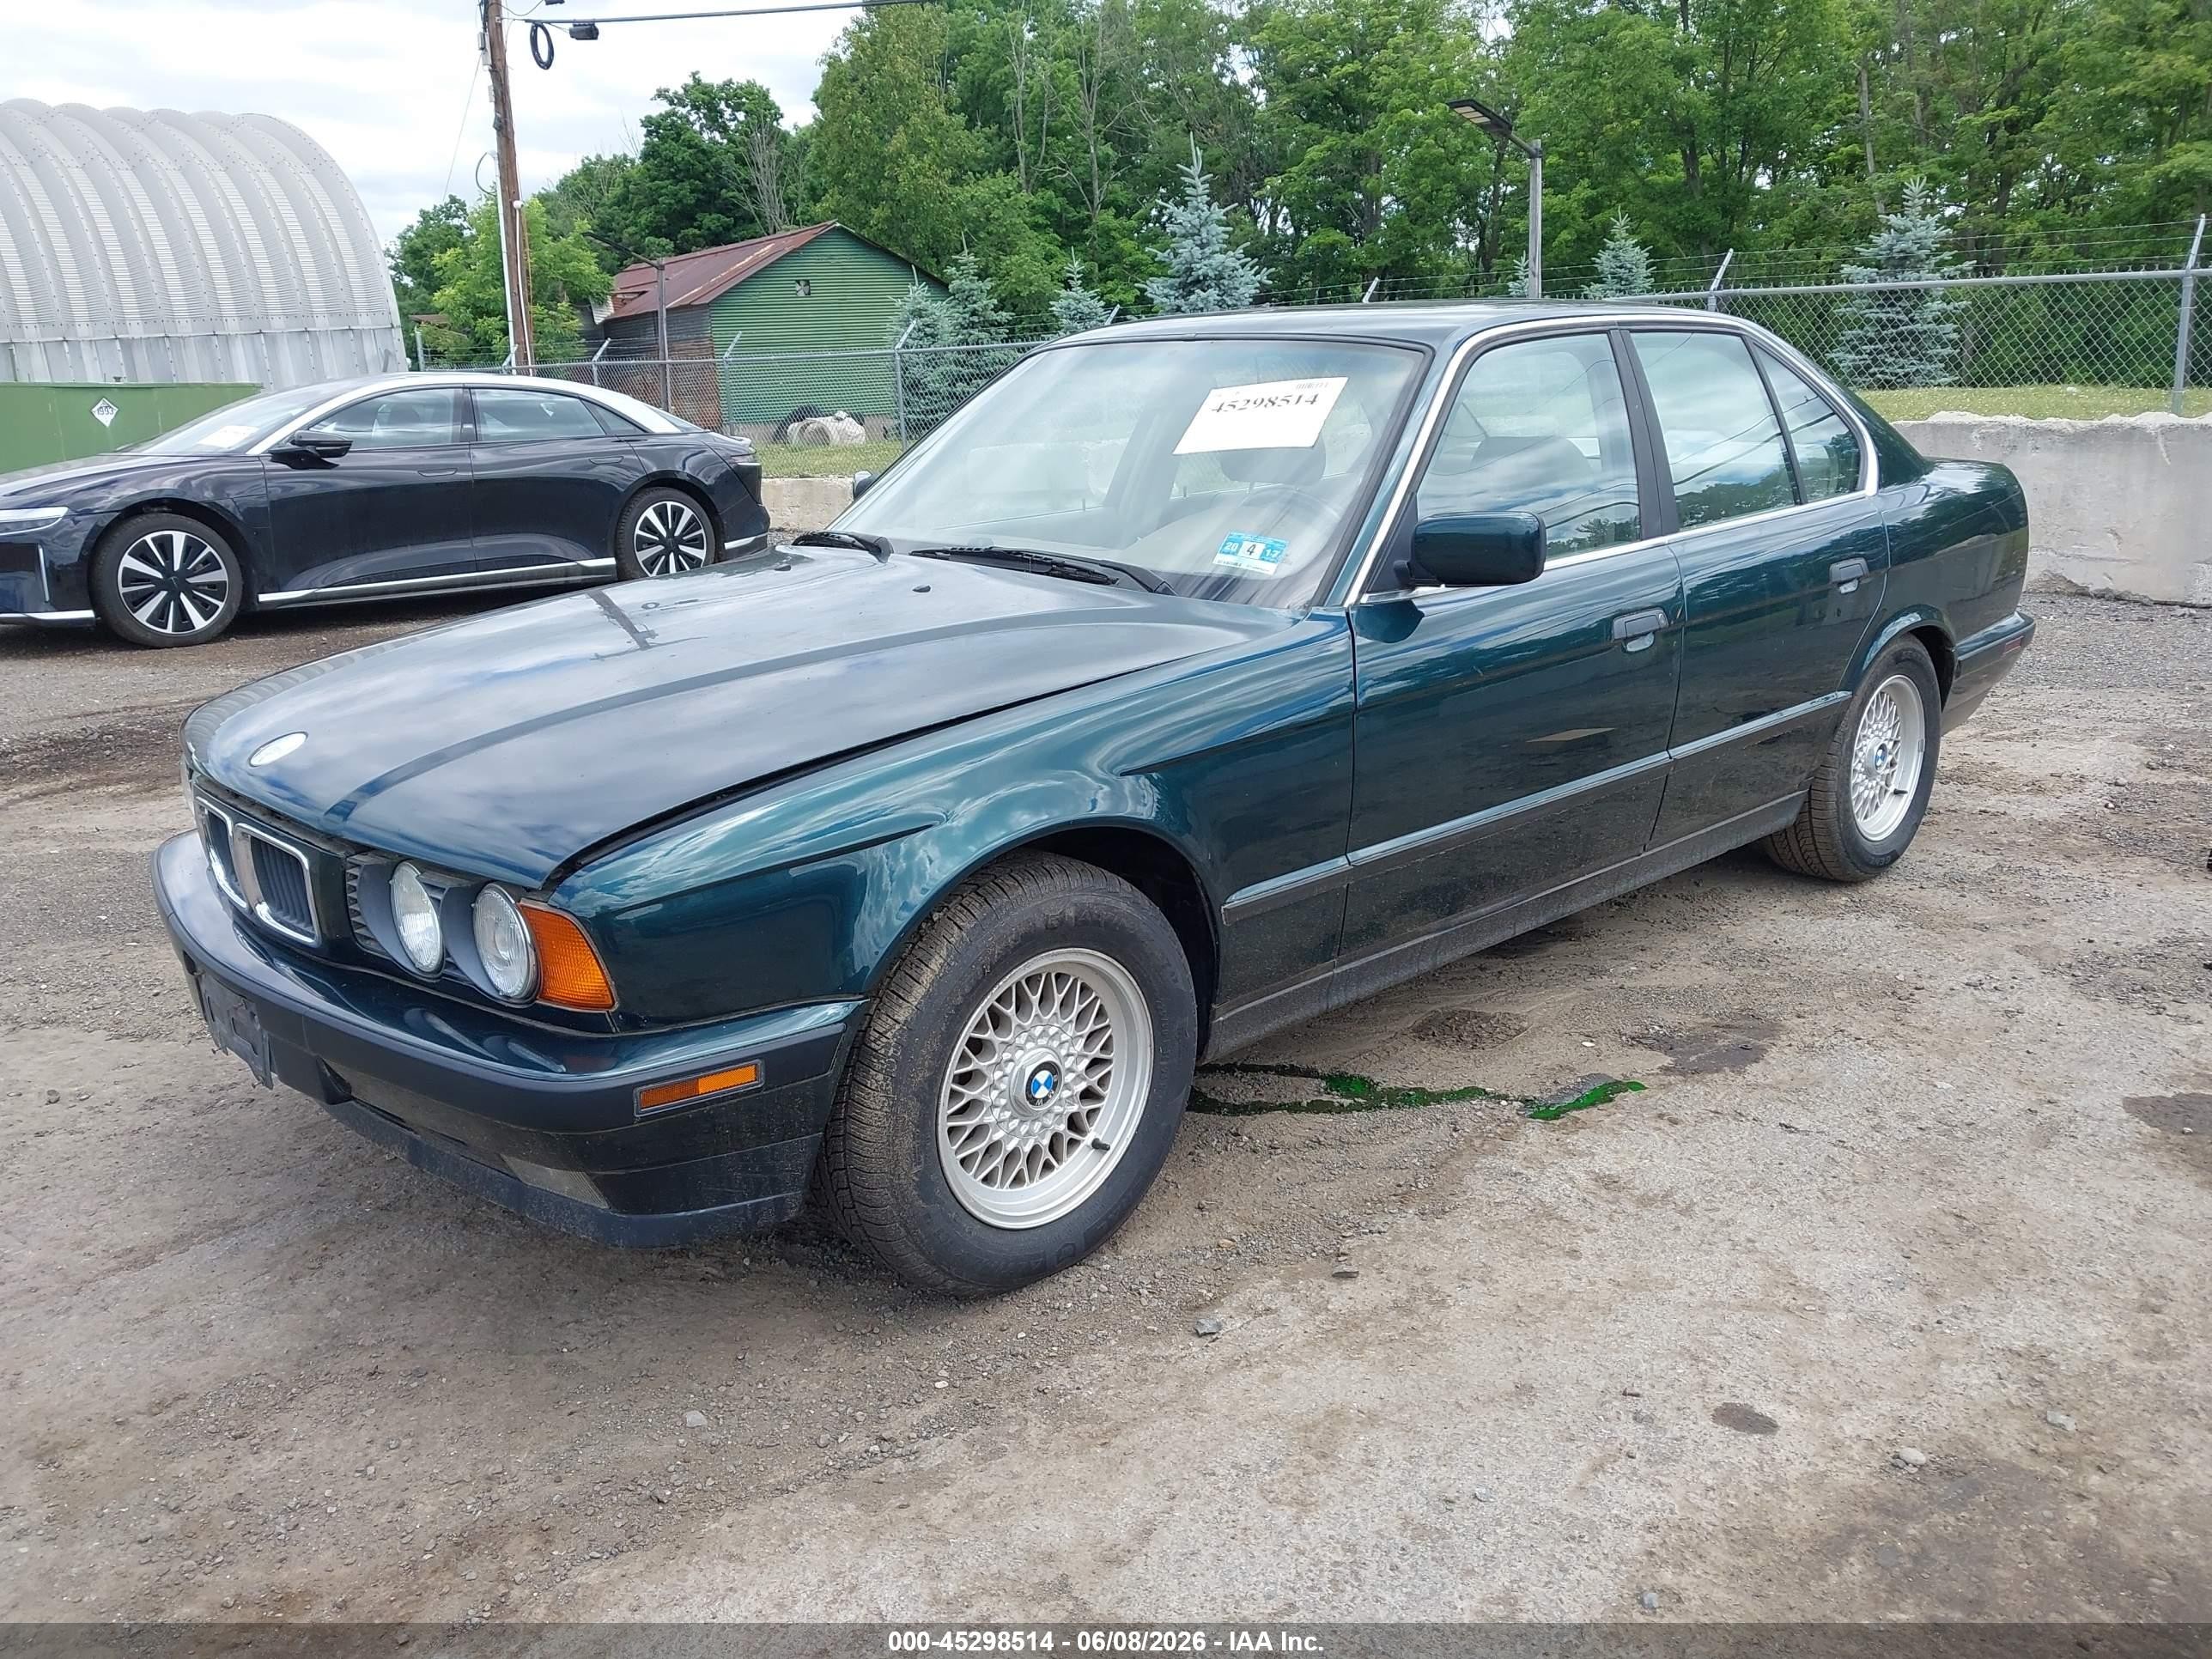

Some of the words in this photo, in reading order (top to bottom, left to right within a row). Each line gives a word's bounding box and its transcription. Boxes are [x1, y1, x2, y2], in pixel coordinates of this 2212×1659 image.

[1211, 393, 1319, 412] 45298514
[97, 405, 114, 416] 1993
[1224, 542, 1239, 551] 20
[1246, 544, 1257, 556] 4
